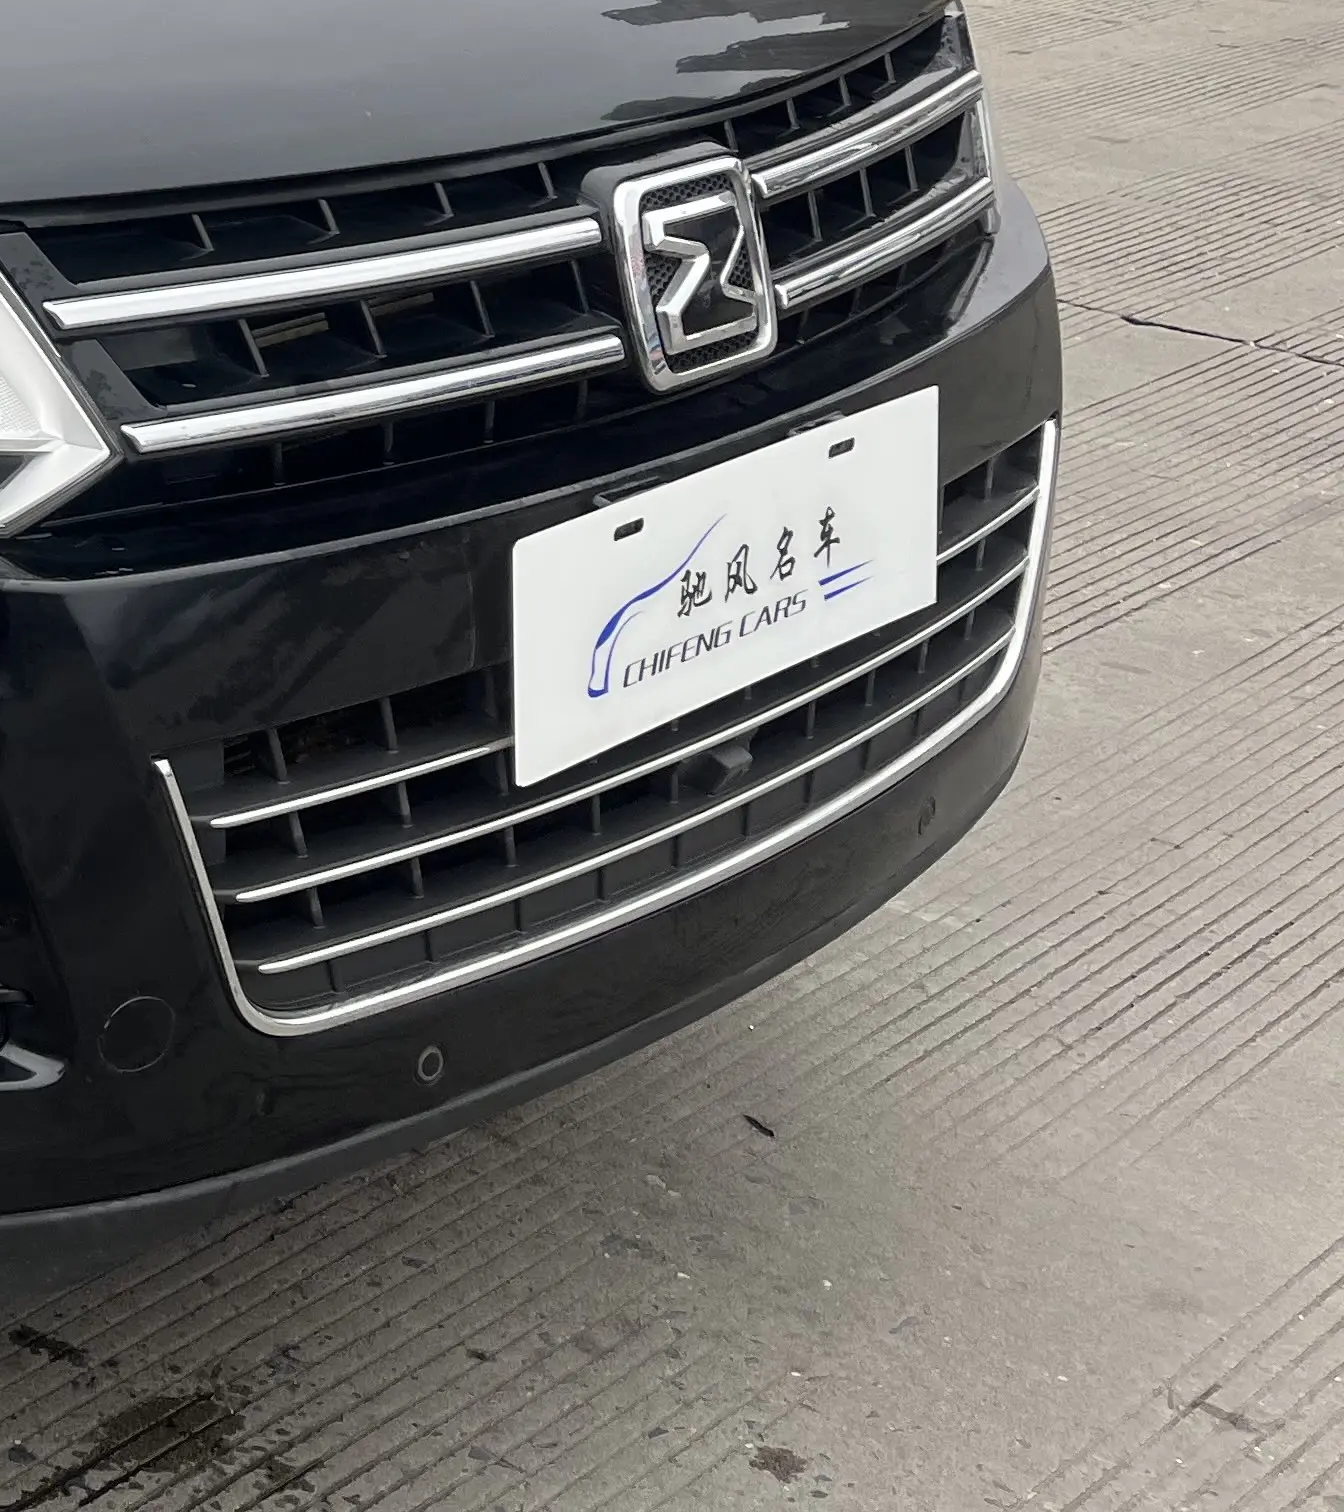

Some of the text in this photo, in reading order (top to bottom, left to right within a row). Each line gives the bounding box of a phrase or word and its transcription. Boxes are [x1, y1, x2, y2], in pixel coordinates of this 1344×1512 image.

[676, 506, 841, 619] 驰风名车
[622, 588, 809, 689] CHIFENG CARS
